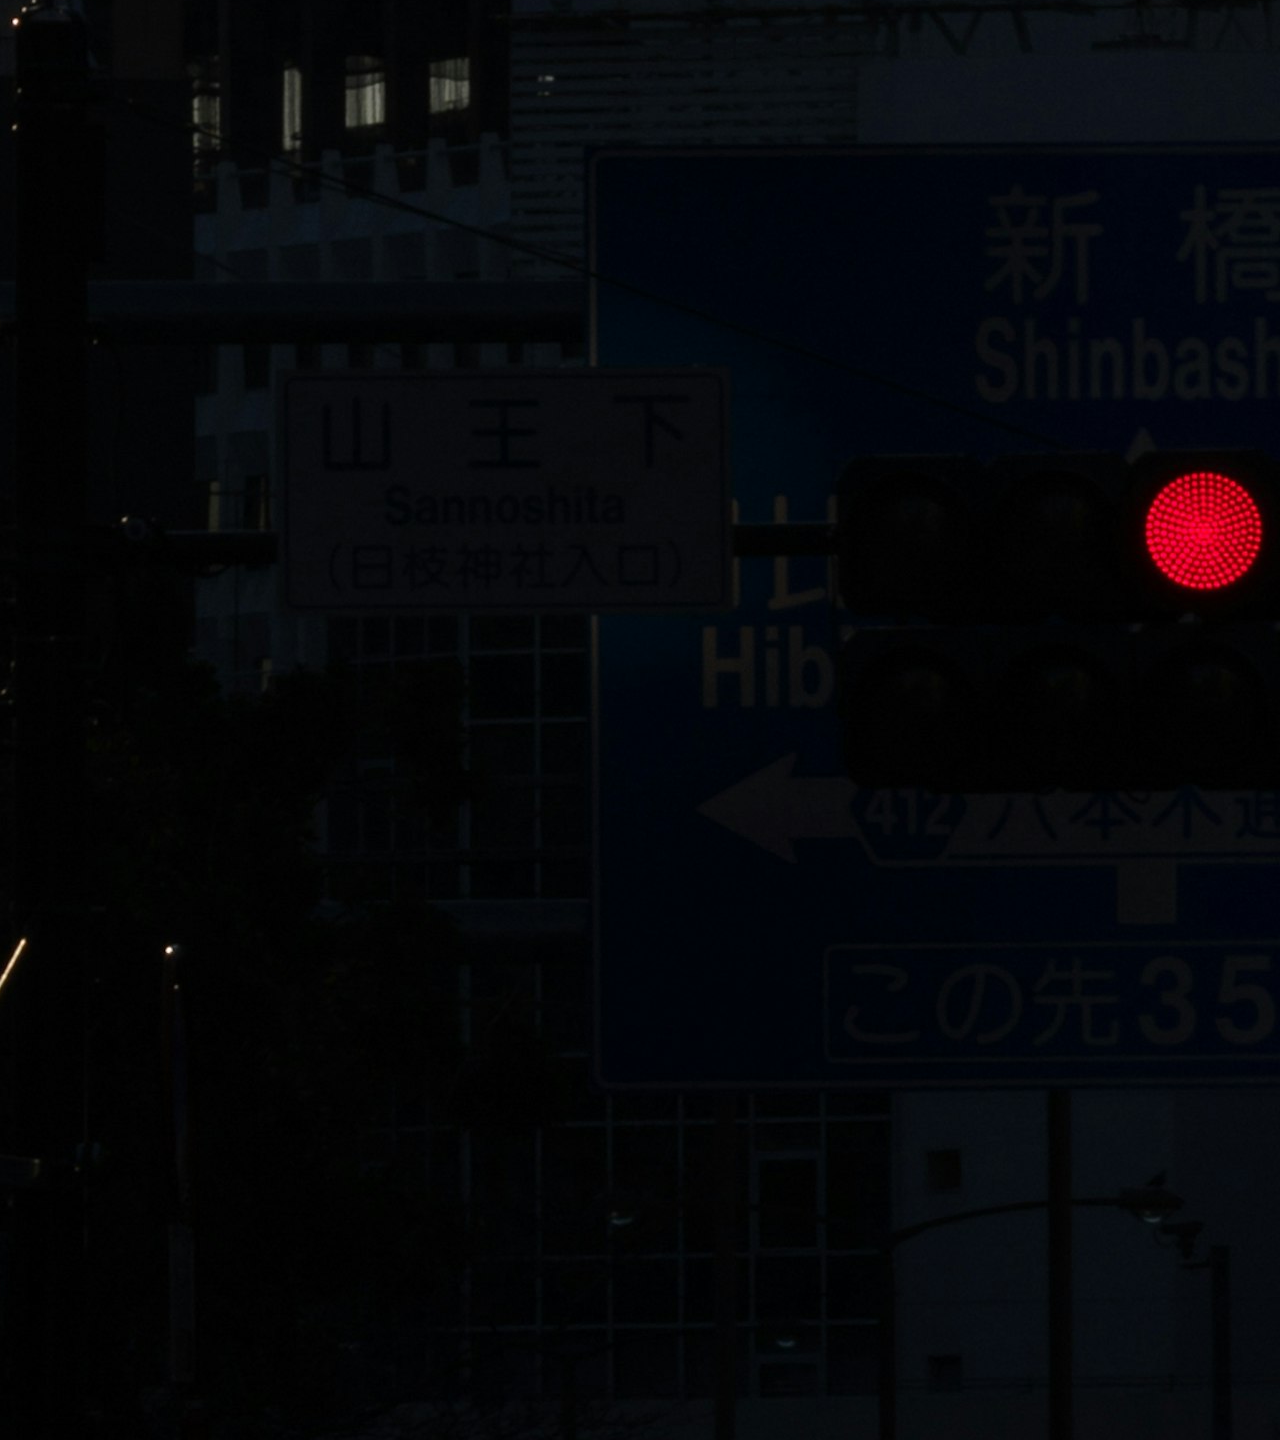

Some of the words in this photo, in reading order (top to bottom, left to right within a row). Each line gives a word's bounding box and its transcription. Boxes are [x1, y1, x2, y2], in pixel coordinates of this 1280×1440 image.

[321, 393, 691, 472] 山王下
[383, 483, 626, 527] Sannoshita
[860, 785, 952, 837] 412
